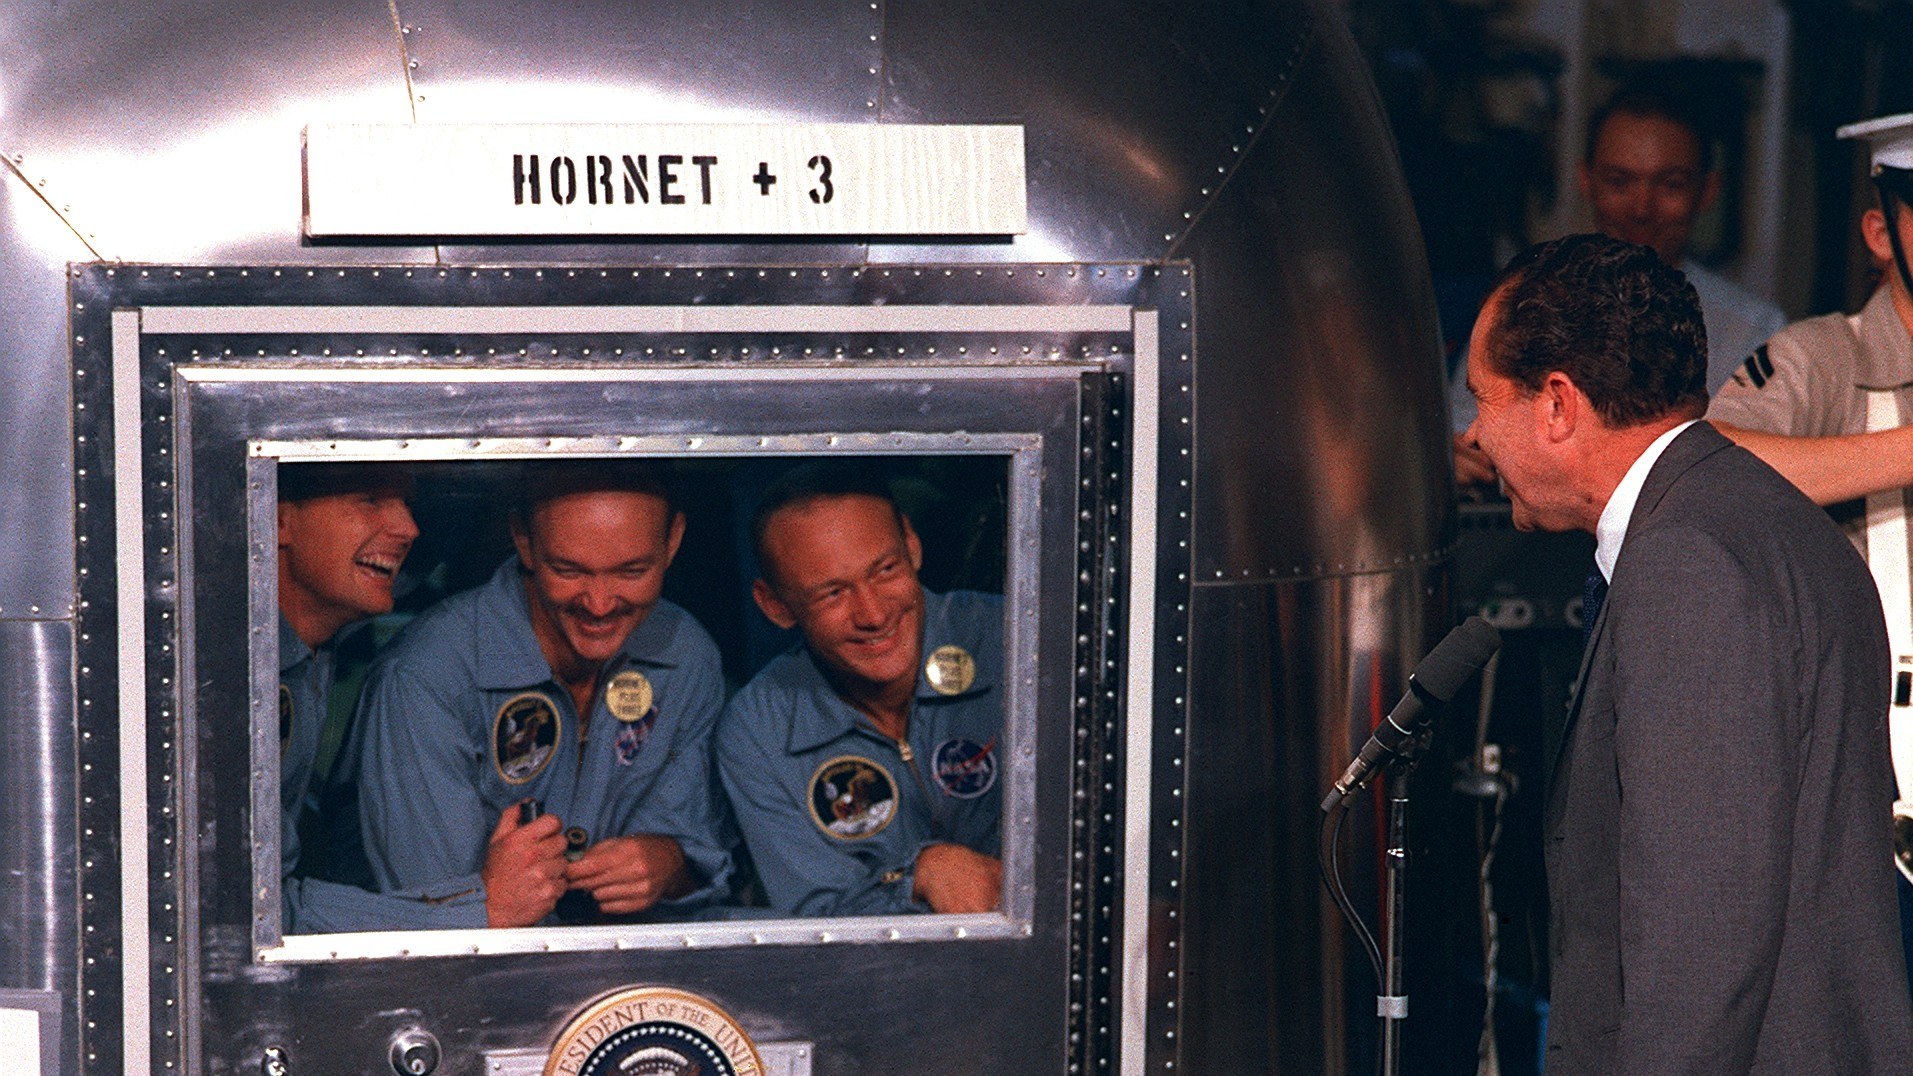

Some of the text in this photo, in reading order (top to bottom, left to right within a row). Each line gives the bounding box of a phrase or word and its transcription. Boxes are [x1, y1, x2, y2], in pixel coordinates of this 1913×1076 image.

[512, 154, 834, 206] HORNET + 3
[655, 1002, 675, 1017] OF
[681, 1006, 708, 1027] THE
